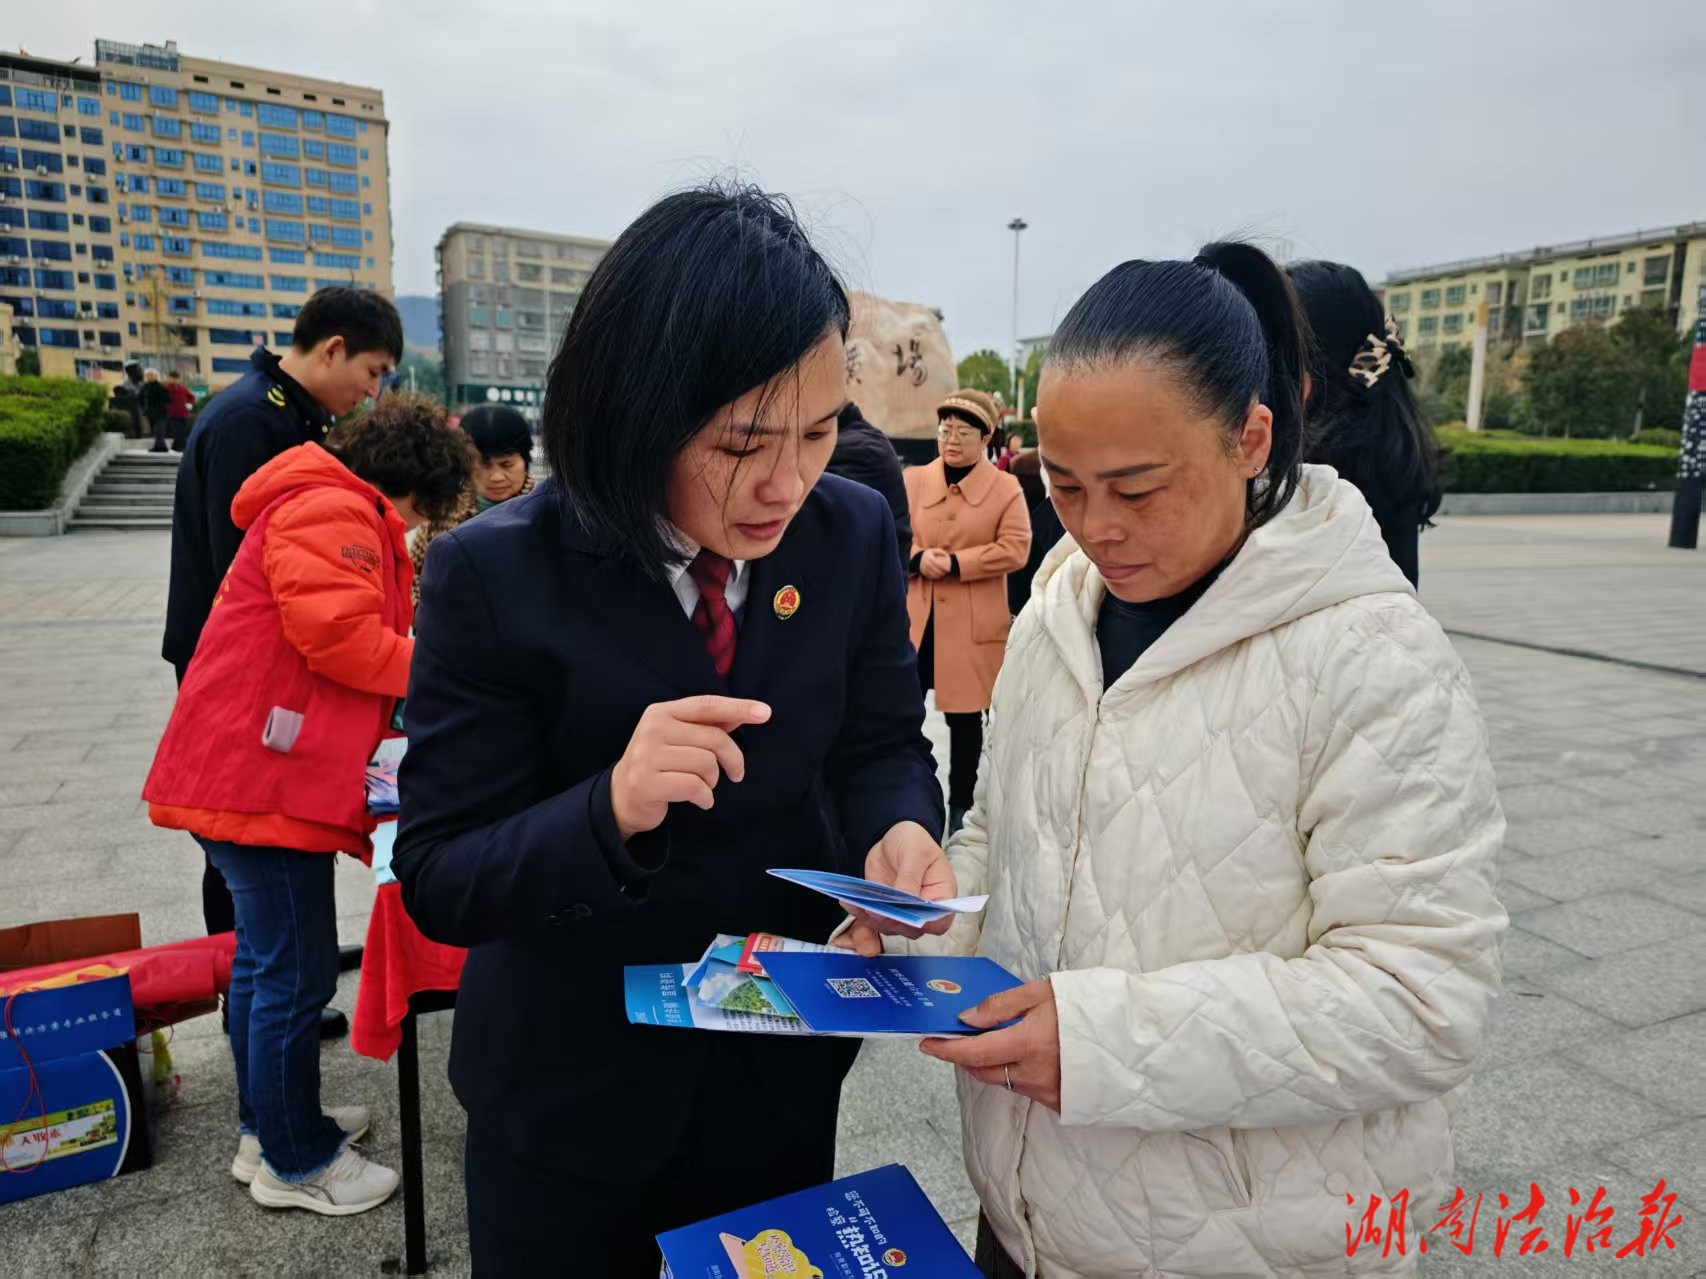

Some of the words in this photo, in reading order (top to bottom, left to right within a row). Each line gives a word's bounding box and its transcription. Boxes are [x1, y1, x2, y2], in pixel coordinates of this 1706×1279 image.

[844, 1190, 887, 1245] 您不可不知的
